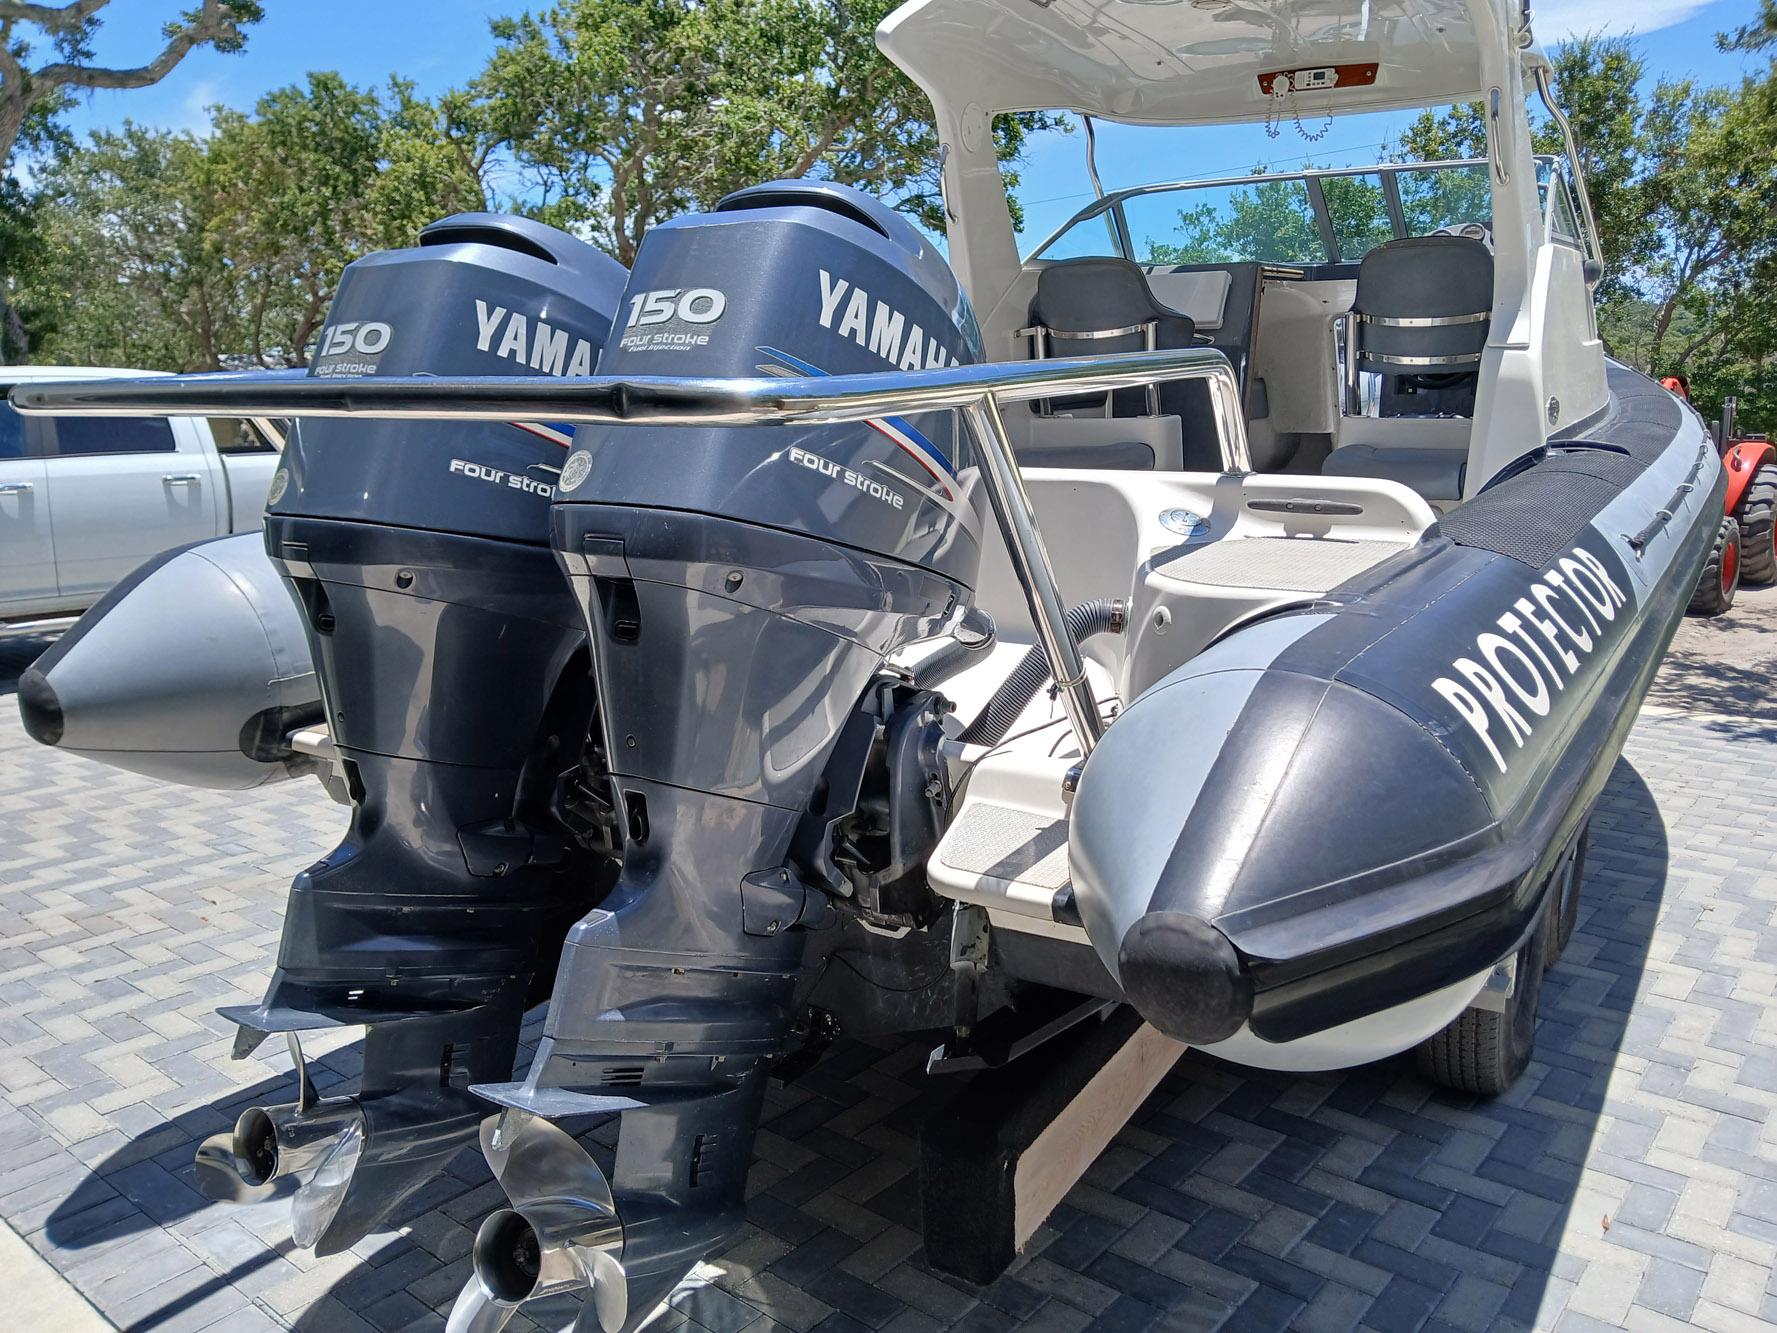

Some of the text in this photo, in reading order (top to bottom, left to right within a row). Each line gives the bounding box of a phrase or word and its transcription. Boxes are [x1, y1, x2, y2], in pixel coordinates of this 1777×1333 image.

[320, 322, 391, 356] 150
[475, 299, 603, 376] YAMA
[627, 288, 726, 328] 150
[819, 269, 959, 371] YAMAH
[1431, 547, 1627, 774] PROTECTOR
